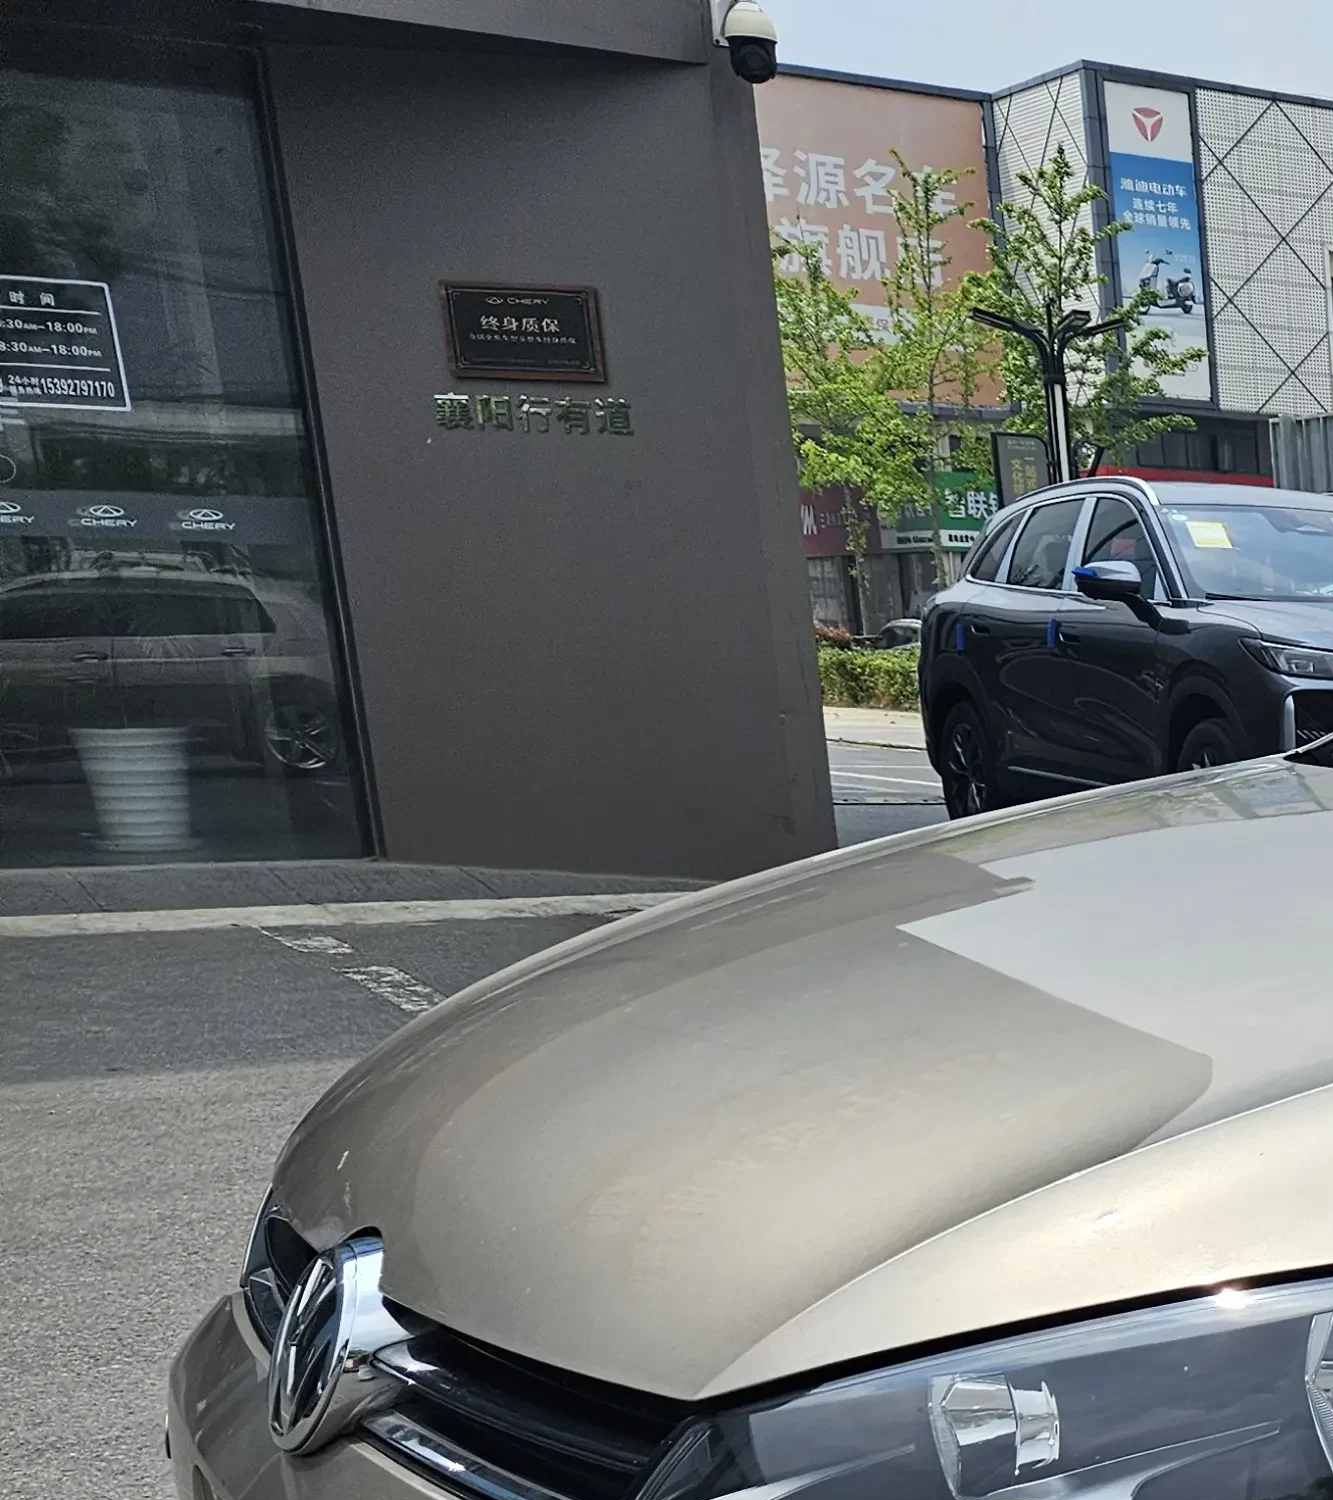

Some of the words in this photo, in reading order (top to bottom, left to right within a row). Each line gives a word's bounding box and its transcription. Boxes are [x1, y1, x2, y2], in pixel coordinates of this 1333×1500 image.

[1120, 177, 1188, 197] 雅迪电动车
[1132, 198, 1178, 214] 连续七年
[1122, 210, 1191, 231] 全球销量领先
[479, 315, 560, 333] 终身质保
[40, 378, 115, 398] 15392797170
[433, 393, 635, 436] 襄阳行有道
[80, 517, 137, 528] CHERY
[181, 521, 236, 531] CHERY
